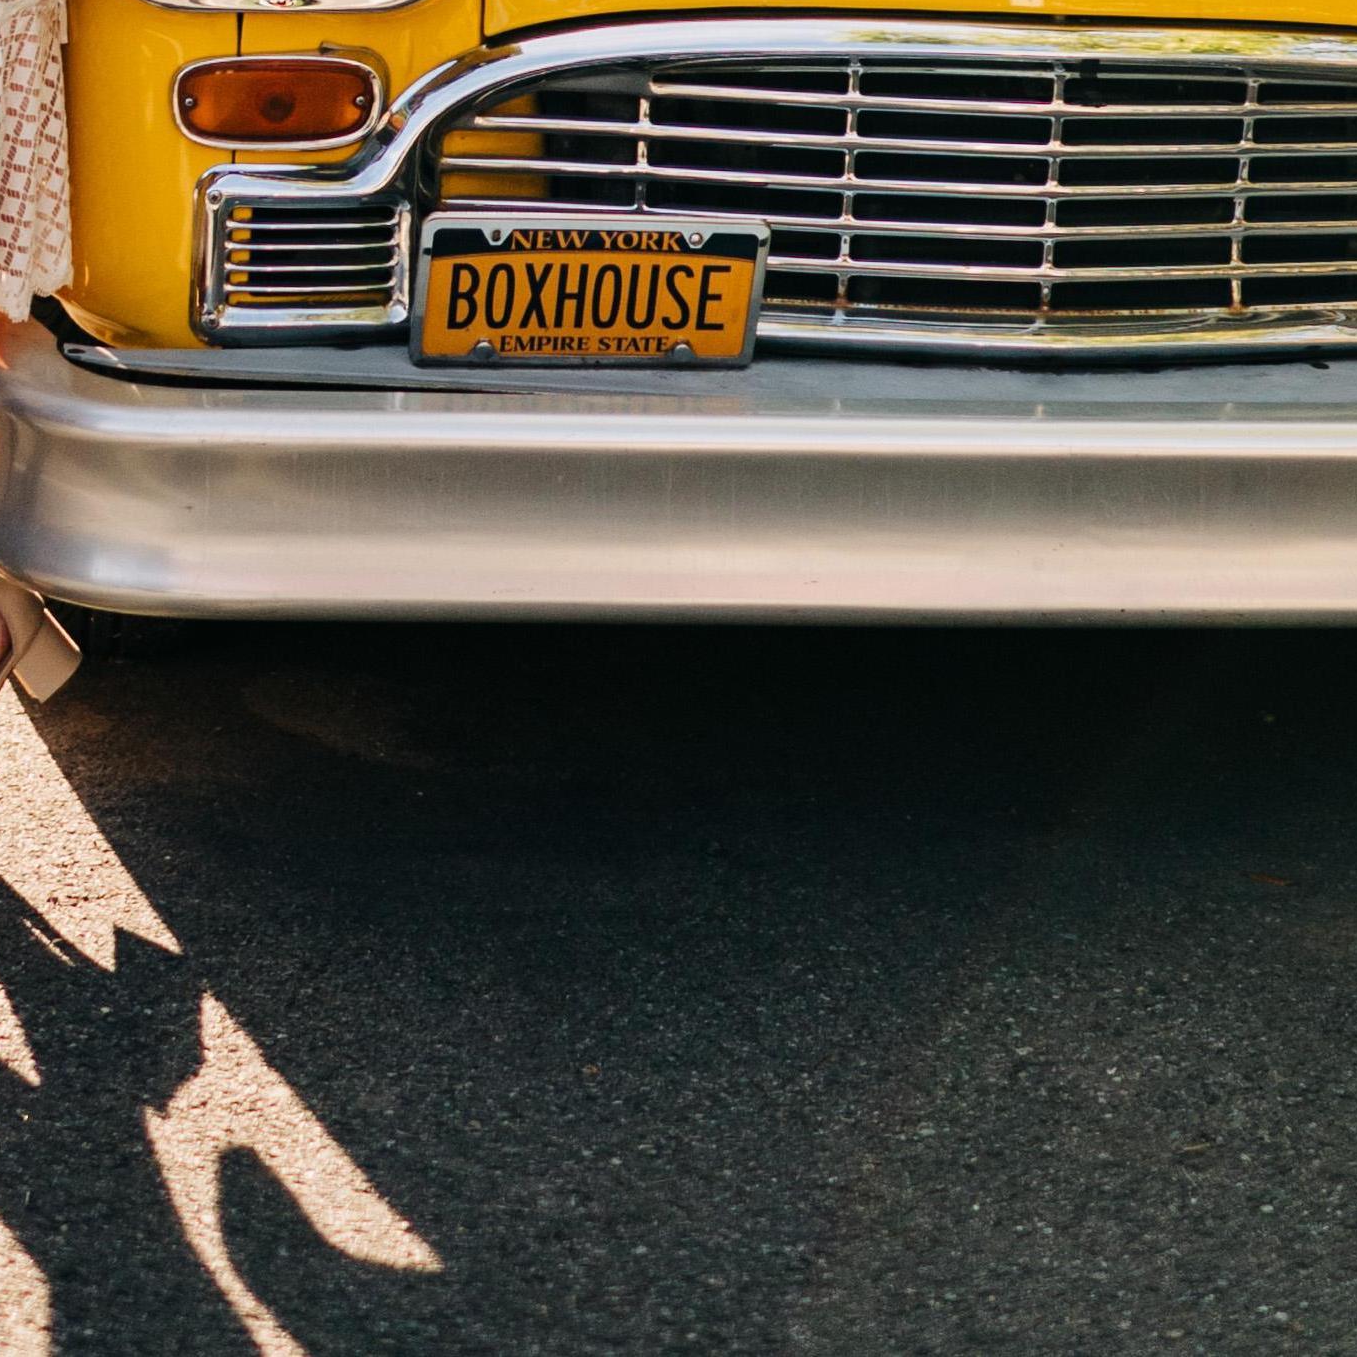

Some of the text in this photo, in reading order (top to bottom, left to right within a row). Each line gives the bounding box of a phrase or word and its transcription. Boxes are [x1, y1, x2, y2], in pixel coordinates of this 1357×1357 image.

[510, 230, 681, 253] NEW YORK
[446, 262, 732, 331] BOXHOUSE
[499, 335, 671, 353] EMPIRE STATE
